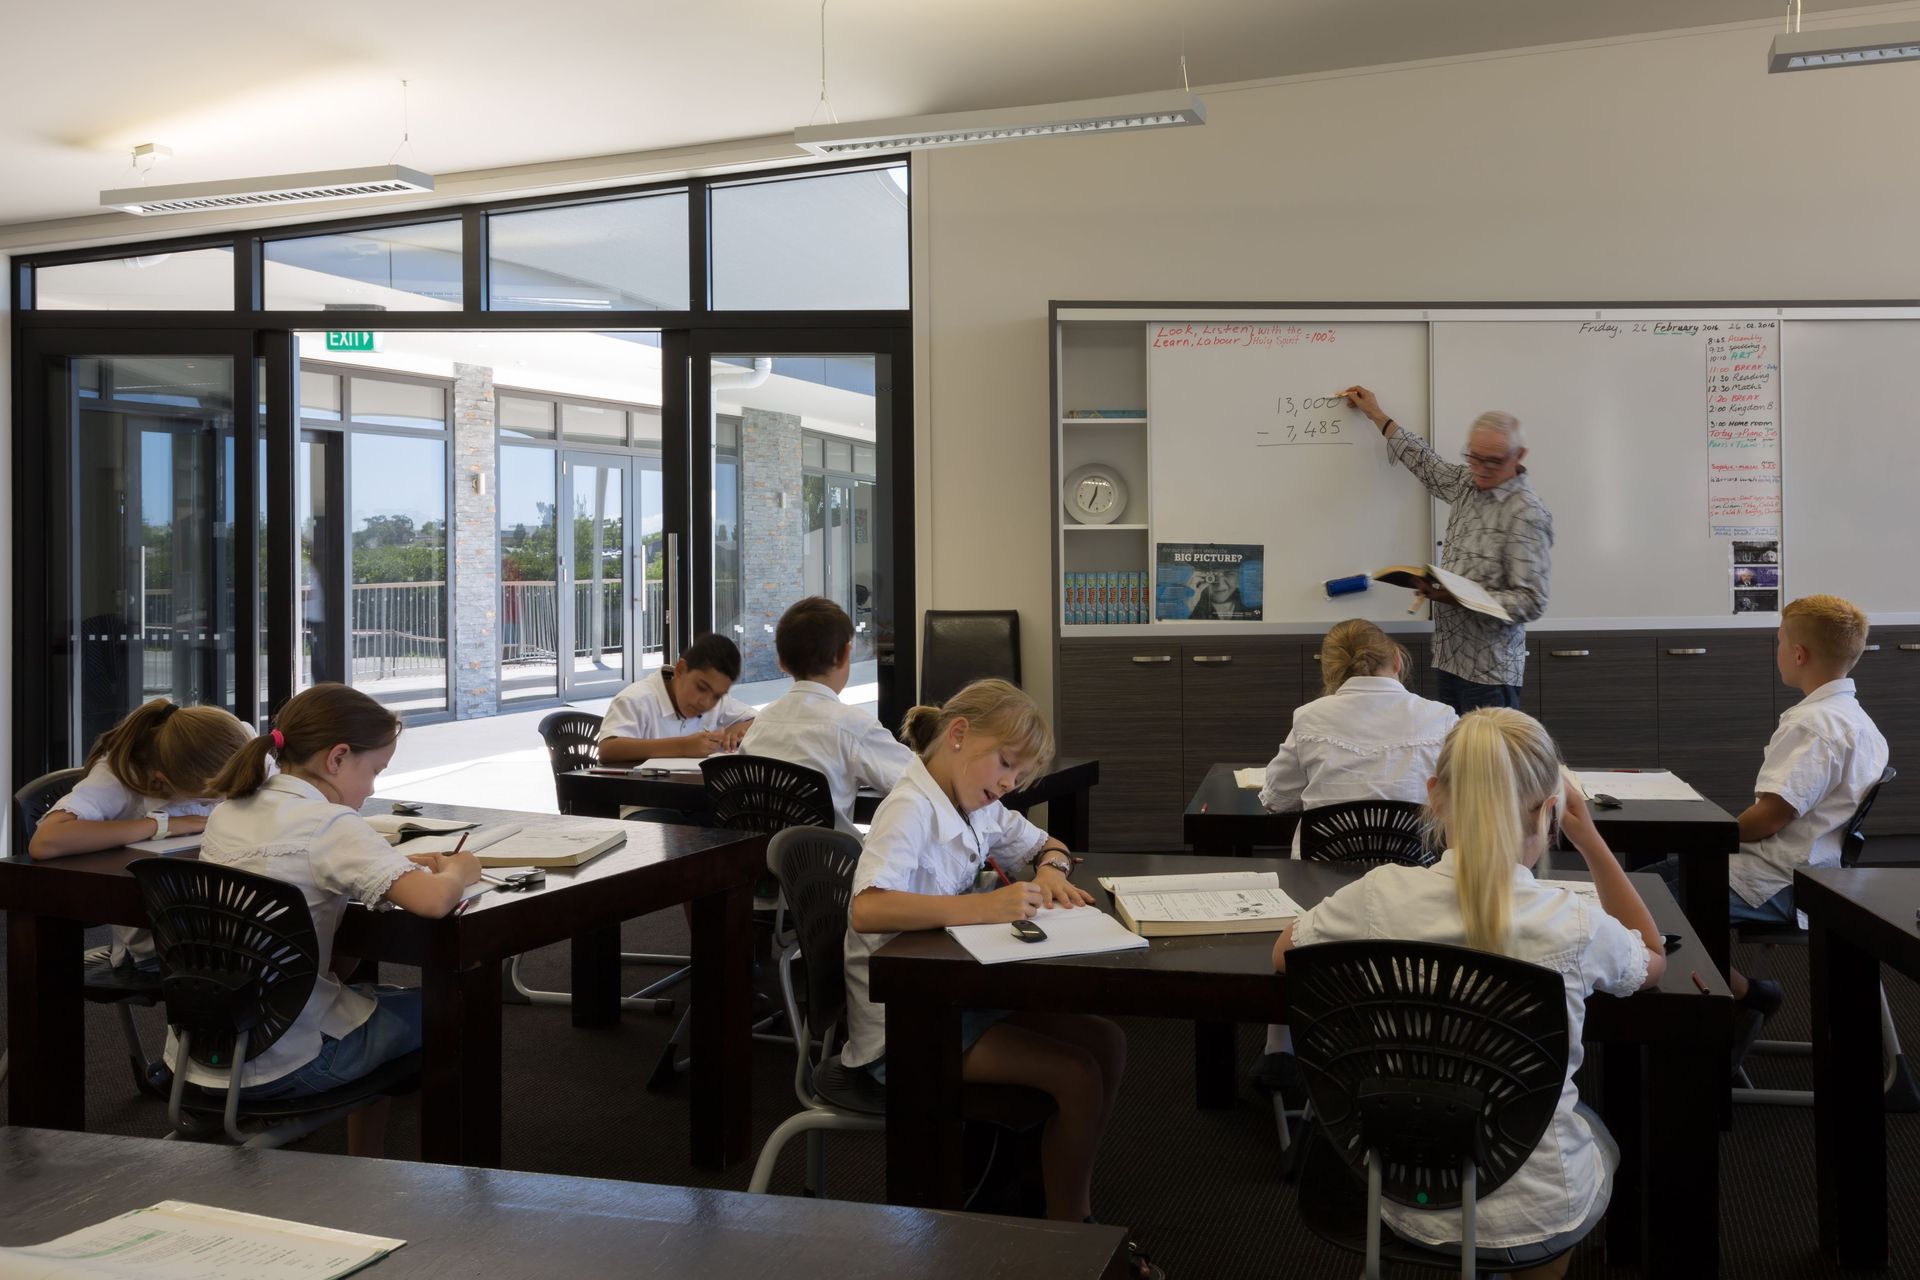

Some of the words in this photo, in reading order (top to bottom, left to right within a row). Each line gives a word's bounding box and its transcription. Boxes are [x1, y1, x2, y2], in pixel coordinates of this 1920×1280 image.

[1158, 324, 1197, 337] Look,
[1258, 325, 1281, 335] with
[1287, 325, 1302, 334] the
[1579, 322, 1622, 338] Friday,
[1654, 322, 1699, 336] February
[330, 331, 359, 346] EXIT
[1253, 336, 1272, 348] Holy
[1276, 335, 1300, 347] Spirit
[1730, 351, 1753, 359] ART
[1734, 363, 1763, 371] BREAK
[1733, 372, 1769, 383] Reading
[1732, 382, 1762, 391] Maths
[1732, 393, 1760, 402] BREAK
[1729, 403, 1765, 416] Kingdom
[1174, 553, 1192, 562] BIG
[1193, 553, 1243, 563] PICTURE?
